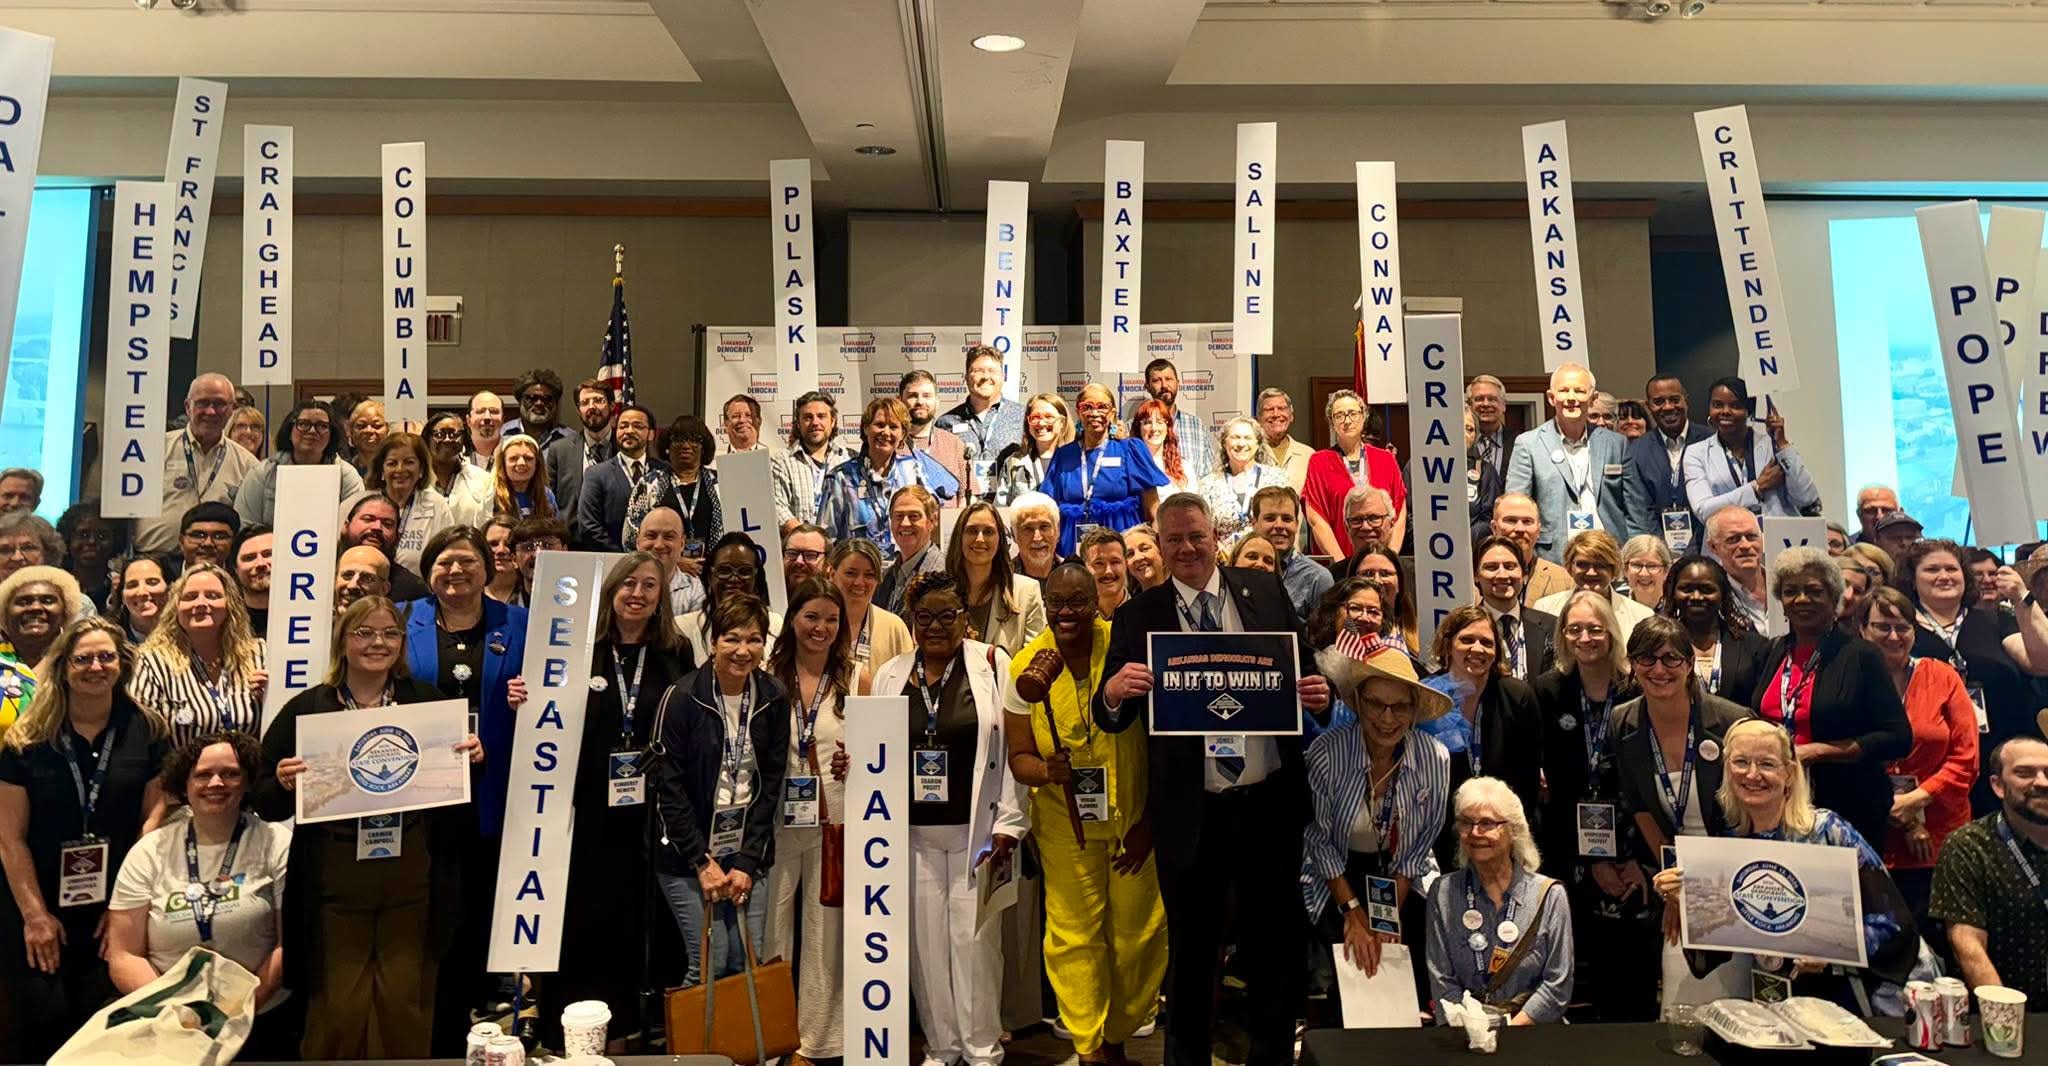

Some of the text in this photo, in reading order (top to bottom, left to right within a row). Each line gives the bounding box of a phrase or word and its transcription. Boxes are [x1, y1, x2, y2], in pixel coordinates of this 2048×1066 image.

[169, 95, 211, 321] ST FRANCIS
[258, 140, 280, 369] CRAIGHEAD
[394, 166, 415, 400] COLUMBIA
[784, 186, 806, 372] PULASKI
[1113, 180, 1132, 334] BAXTER
[1246, 162, 1262, 314] SALINE
[1370, 203, 1393, 362] CONWAY
[1537, 143, 1573, 351] ARKANSAS
[1714, 125, 1779, 377] CRITTENDEN
[120, 202, 156, 497] HEMPSTEAD
[427, 314, 454, 340] XIT
[1949, 284, 2007, 465] POPE
[372, 755, 417, 765] CONVENTION
[513, 575, 579, 945] SEBASTIAN
[1163, 671, 1284, 691] IN IT TO WIN IT
[862, 743, 892, 1058] JACKSON
[1756, 895, 1804, 904] CONVENTION
